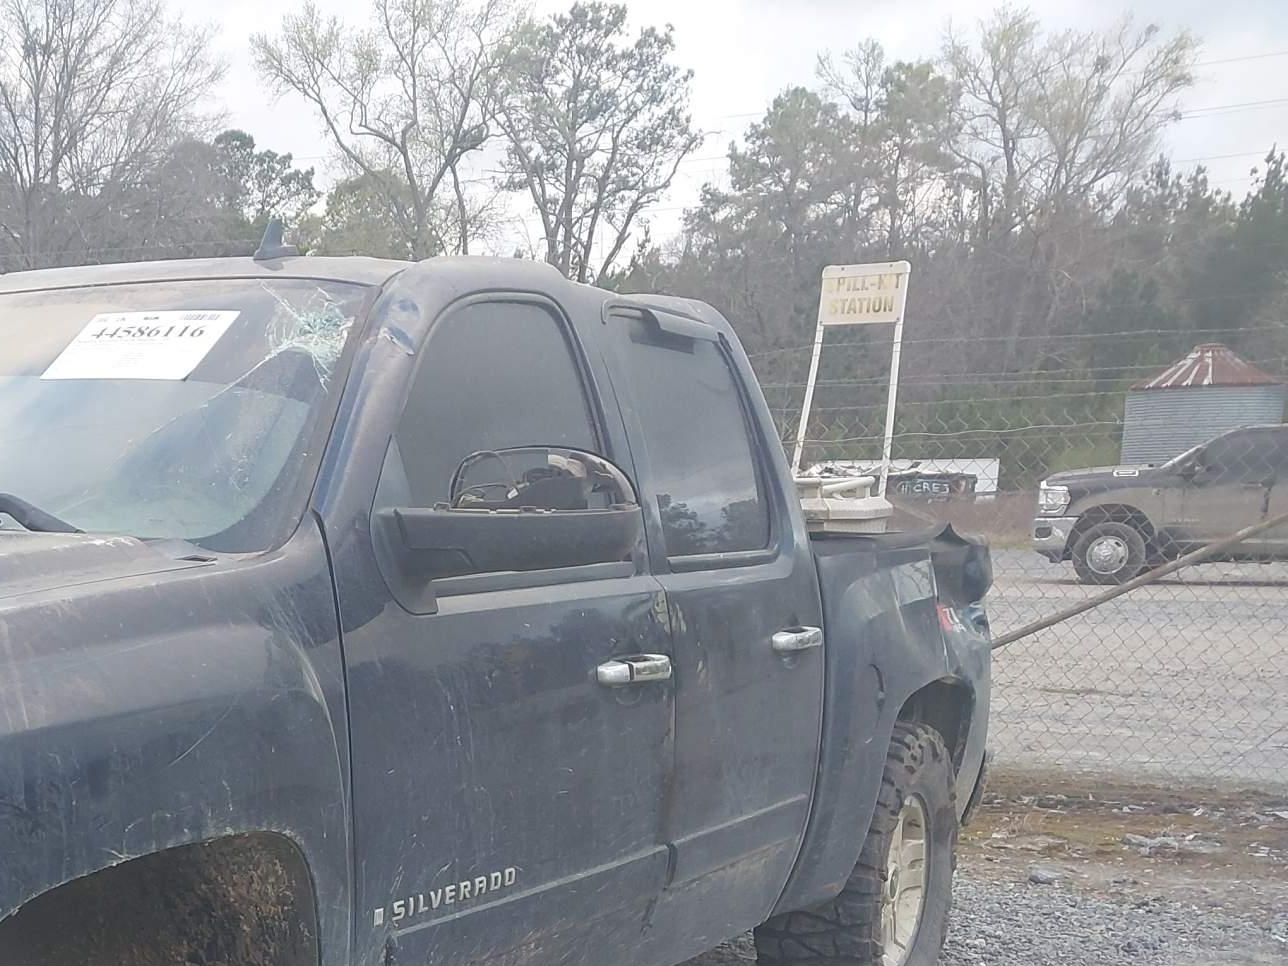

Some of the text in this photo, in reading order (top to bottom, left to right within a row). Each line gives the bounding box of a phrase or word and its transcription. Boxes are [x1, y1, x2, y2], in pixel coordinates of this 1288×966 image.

[829, 296, 894, 315] STATION
[91, 325, 206, 339] 44586116
[391, 867, 516, 922] SILVERADO
